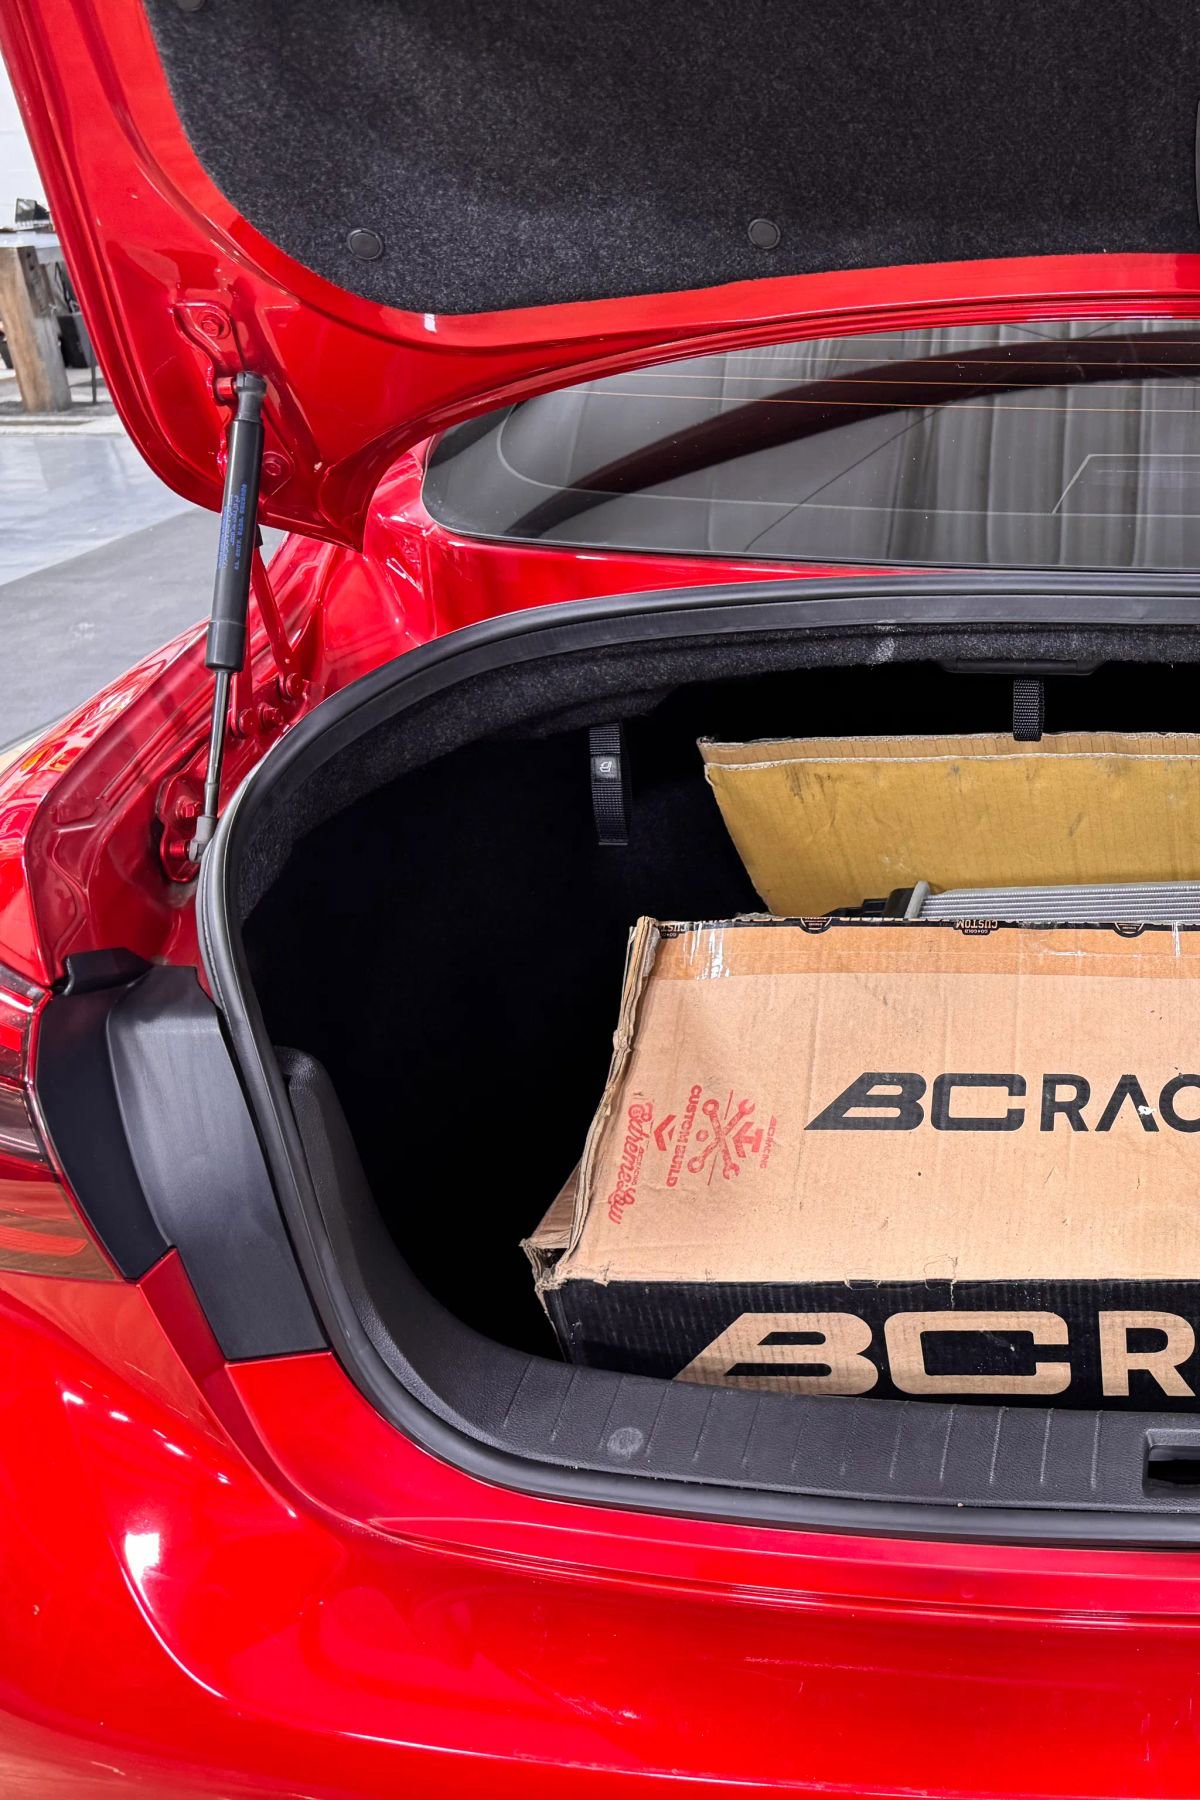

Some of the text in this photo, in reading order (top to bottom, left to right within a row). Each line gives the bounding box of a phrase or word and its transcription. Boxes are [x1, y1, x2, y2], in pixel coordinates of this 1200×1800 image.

[955, 919, 998, 929] CUSTOM
[666, 1084, 703, 1188] CUSTOM BUILD
[804, 1072, 1027, 1131] BC
[673, 1310, 1071, 1395] BC
